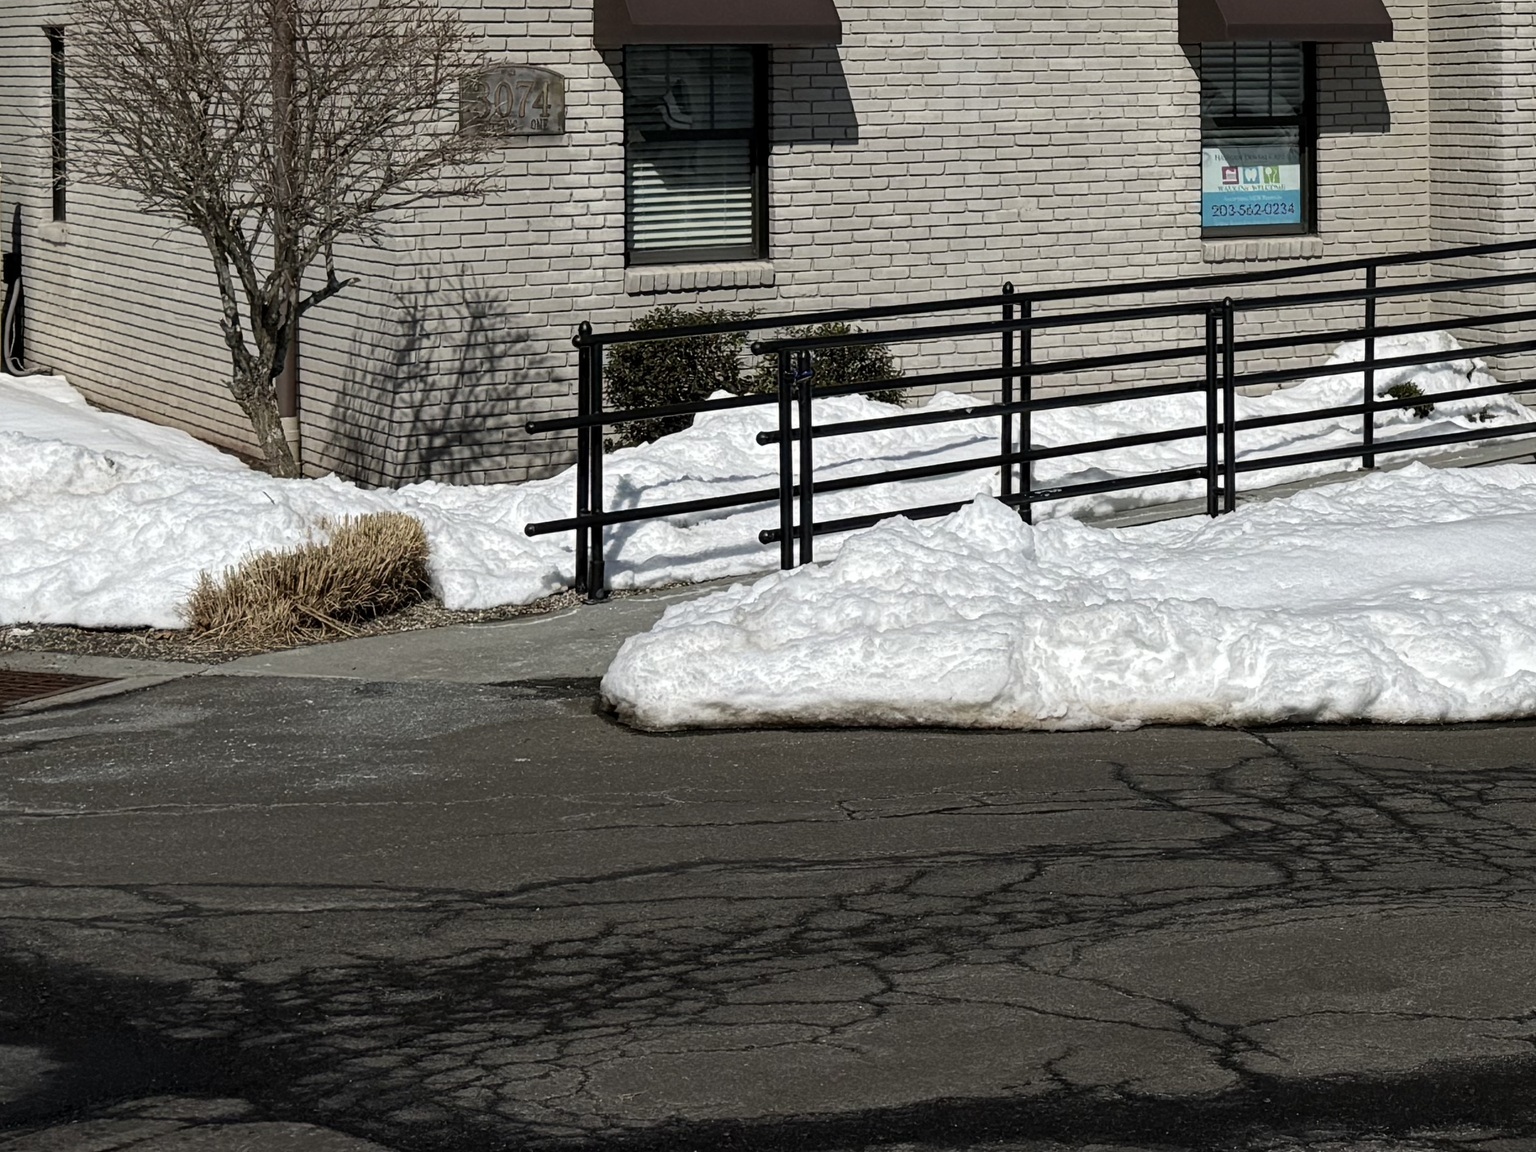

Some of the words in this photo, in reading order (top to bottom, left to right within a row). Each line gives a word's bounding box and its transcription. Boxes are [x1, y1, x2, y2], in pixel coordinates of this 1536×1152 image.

[473, 80, 552, 118] 3074
[530, 118, 548, 130] ONE
[1211, 202, 1295, 217] 203-562-0234
